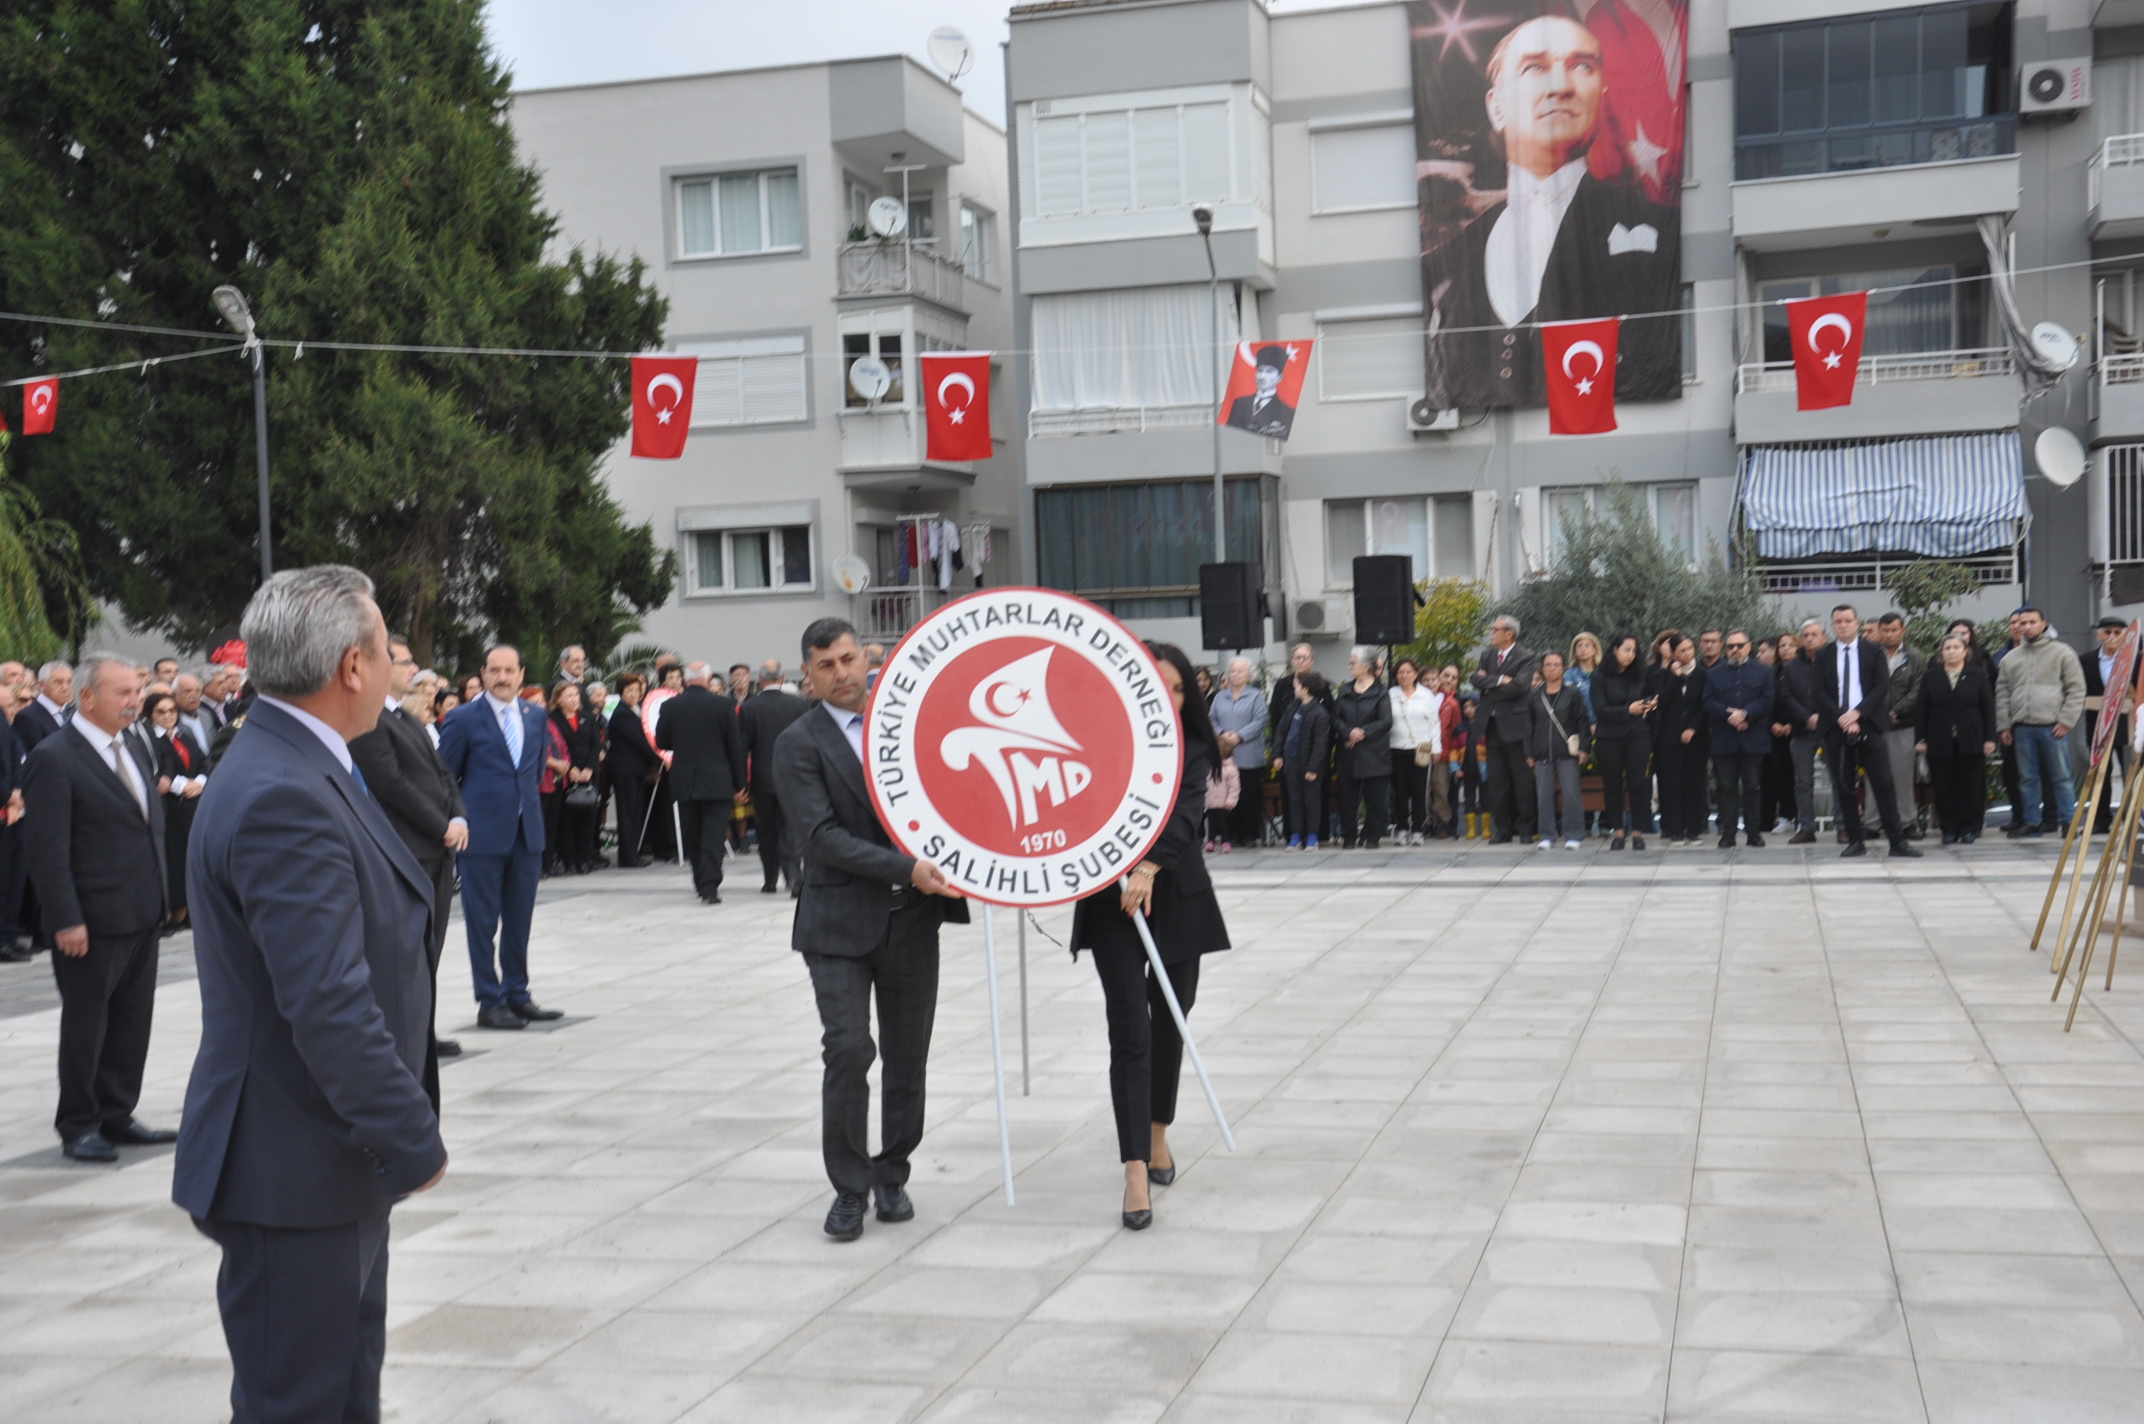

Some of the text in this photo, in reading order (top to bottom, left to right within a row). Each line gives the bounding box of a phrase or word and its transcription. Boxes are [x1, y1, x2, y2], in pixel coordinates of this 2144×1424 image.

[878, 602, 1174, 808] TÜRKİYE MUHTARLAR DERNEĞİ
[922, 791, 1161, 894] SALİHLİ ŞUBESİ
[1020, 828, 1067, 855] 1970
